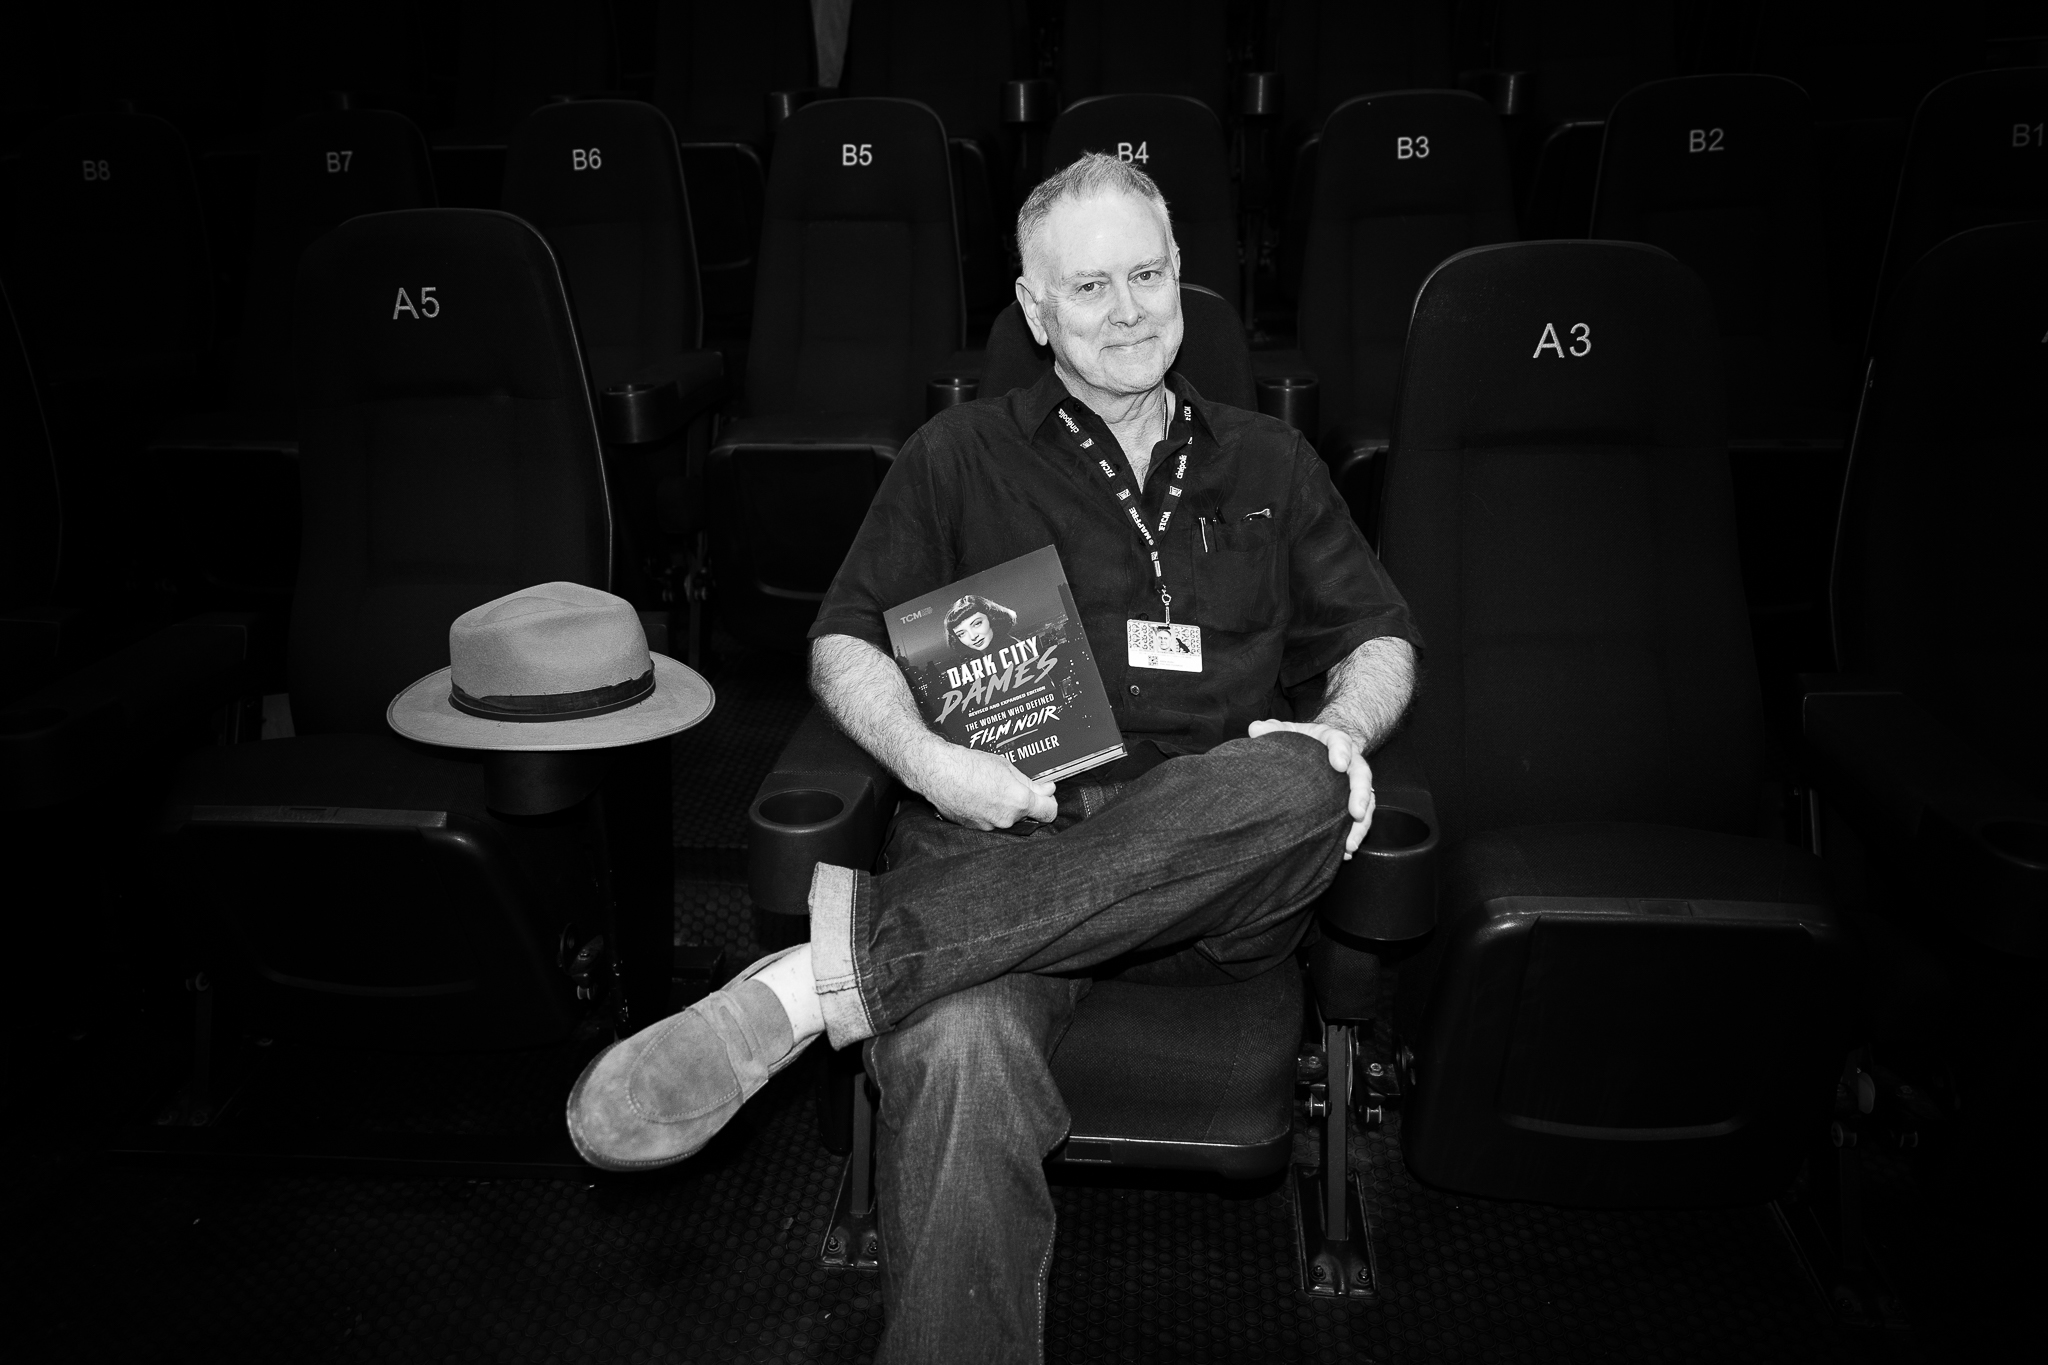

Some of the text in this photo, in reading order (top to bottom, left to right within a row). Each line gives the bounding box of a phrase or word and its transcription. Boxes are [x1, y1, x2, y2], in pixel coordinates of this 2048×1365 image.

[1397, 136, 1430, 159] B3
[1689, 128, 1724, 153] B2
[2012, 124, 2044, 147] B1
[326, 150, 353, 173] B7
[572, 147, 602, 171] B6
[842, 143, 873, 166] B5
[1117, 141, 1150, 164] B4
[82, 159, 111, 181] B8
[393, 286, 440, 320] A5
[1532, 322, 1592, 359] A3
[1099, 459, 1116, 478] FICM
[1128, 506, 1152, 541] MAPFRE
[1158, 511, 1172, 532] FICM
[900, 610, 922, 624] TCM
[946, 635, 1040, 689] DARK CITY
[934, 644, 1059, 725] DAMES
[965, 693, 1055, 732] THE WOMEN WHO DEFINED
[968, 685, 1046, 718] REVISED AND EXPANDED EDITION
[970, 705, 1060, 749] FILM NOIR
[1016, 734, 1060, 760] MULLER
